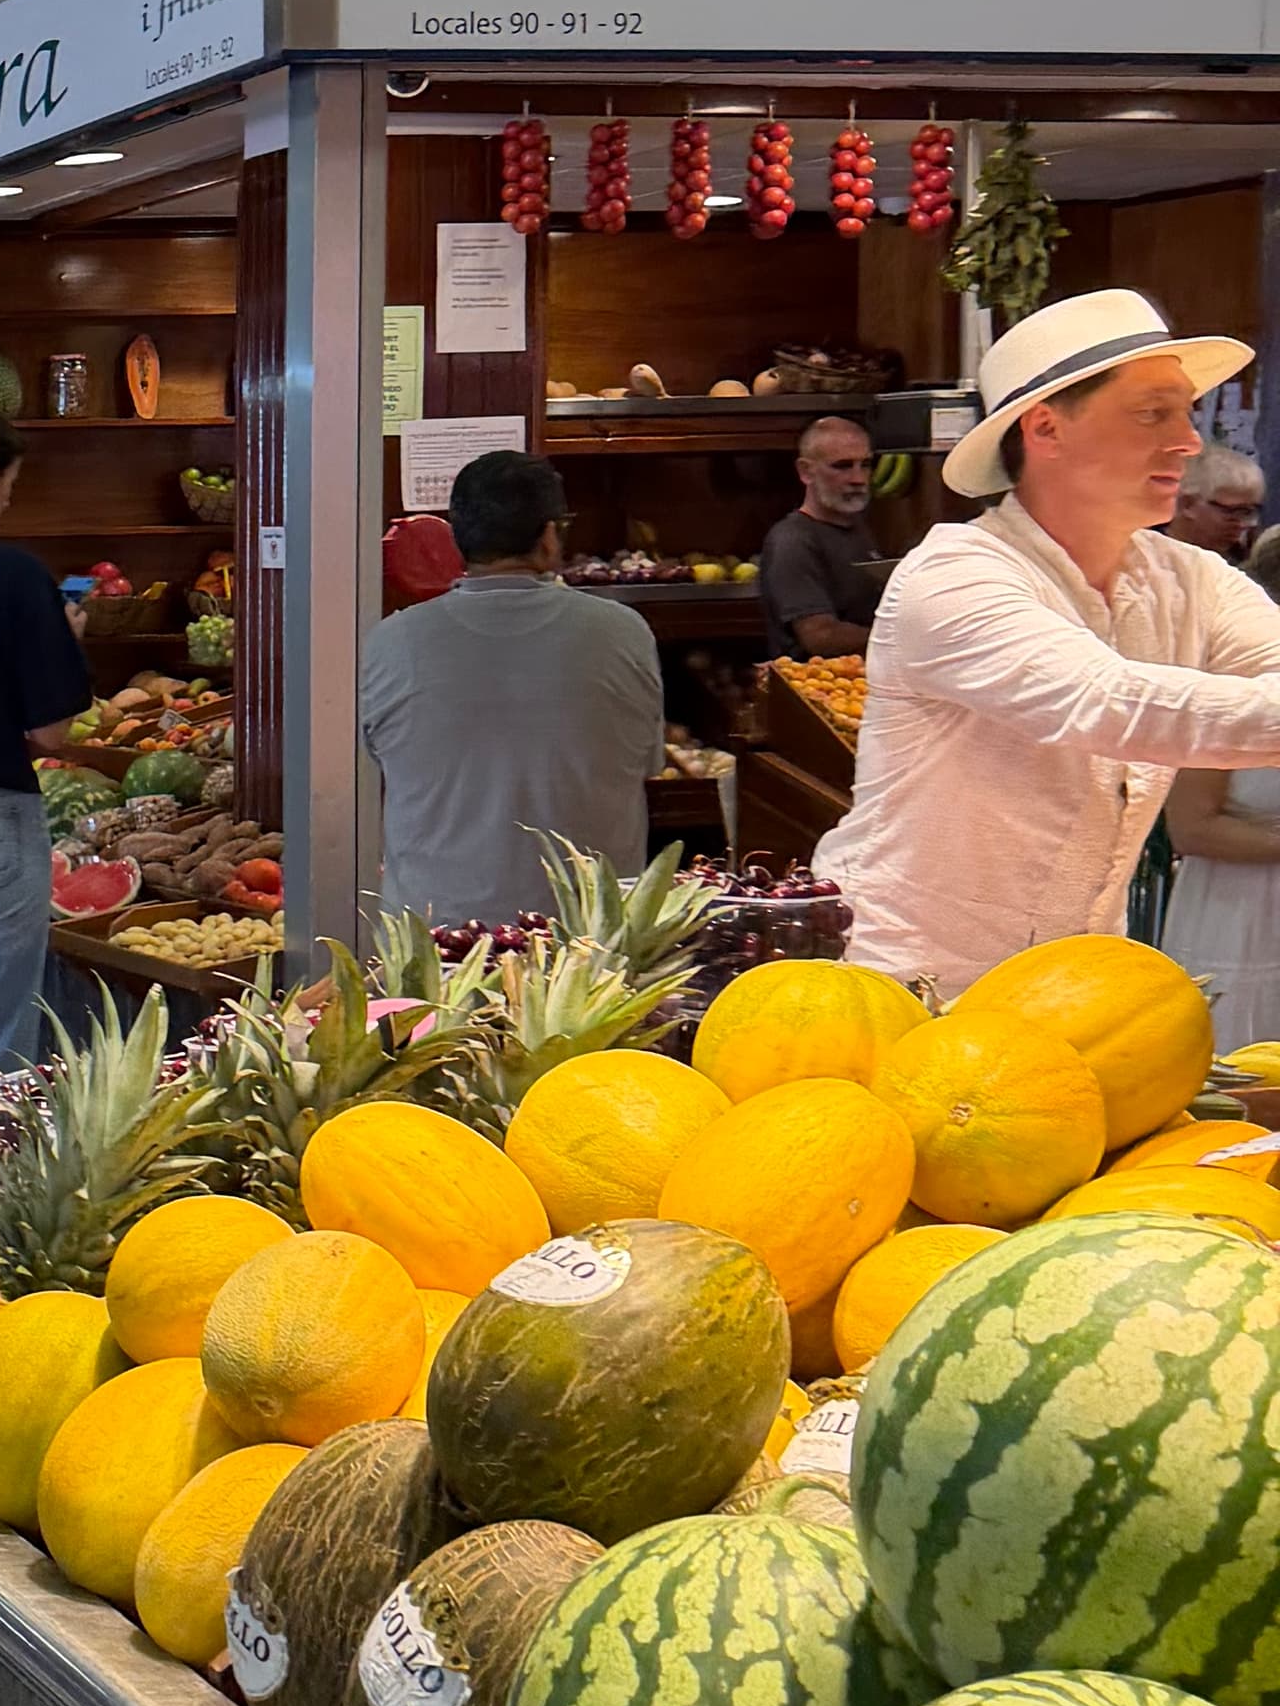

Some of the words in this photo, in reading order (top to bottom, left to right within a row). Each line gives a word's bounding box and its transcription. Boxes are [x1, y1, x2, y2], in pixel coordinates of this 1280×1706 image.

[141, 2, 153, 32] i
[412, 11, 502, 35] Locales
[510, 12, 539, 35] 90
[562, 12, 587, 35] 91
[614, 12, 643, 35] 92
[145, 59, 180, 90] Locales
[180, 51, 194, 75] 90
[200, 44, 213, 69] 91
[221, 36, 235, 60] 92
[382, 1594, 445, 1693] BOLLO
